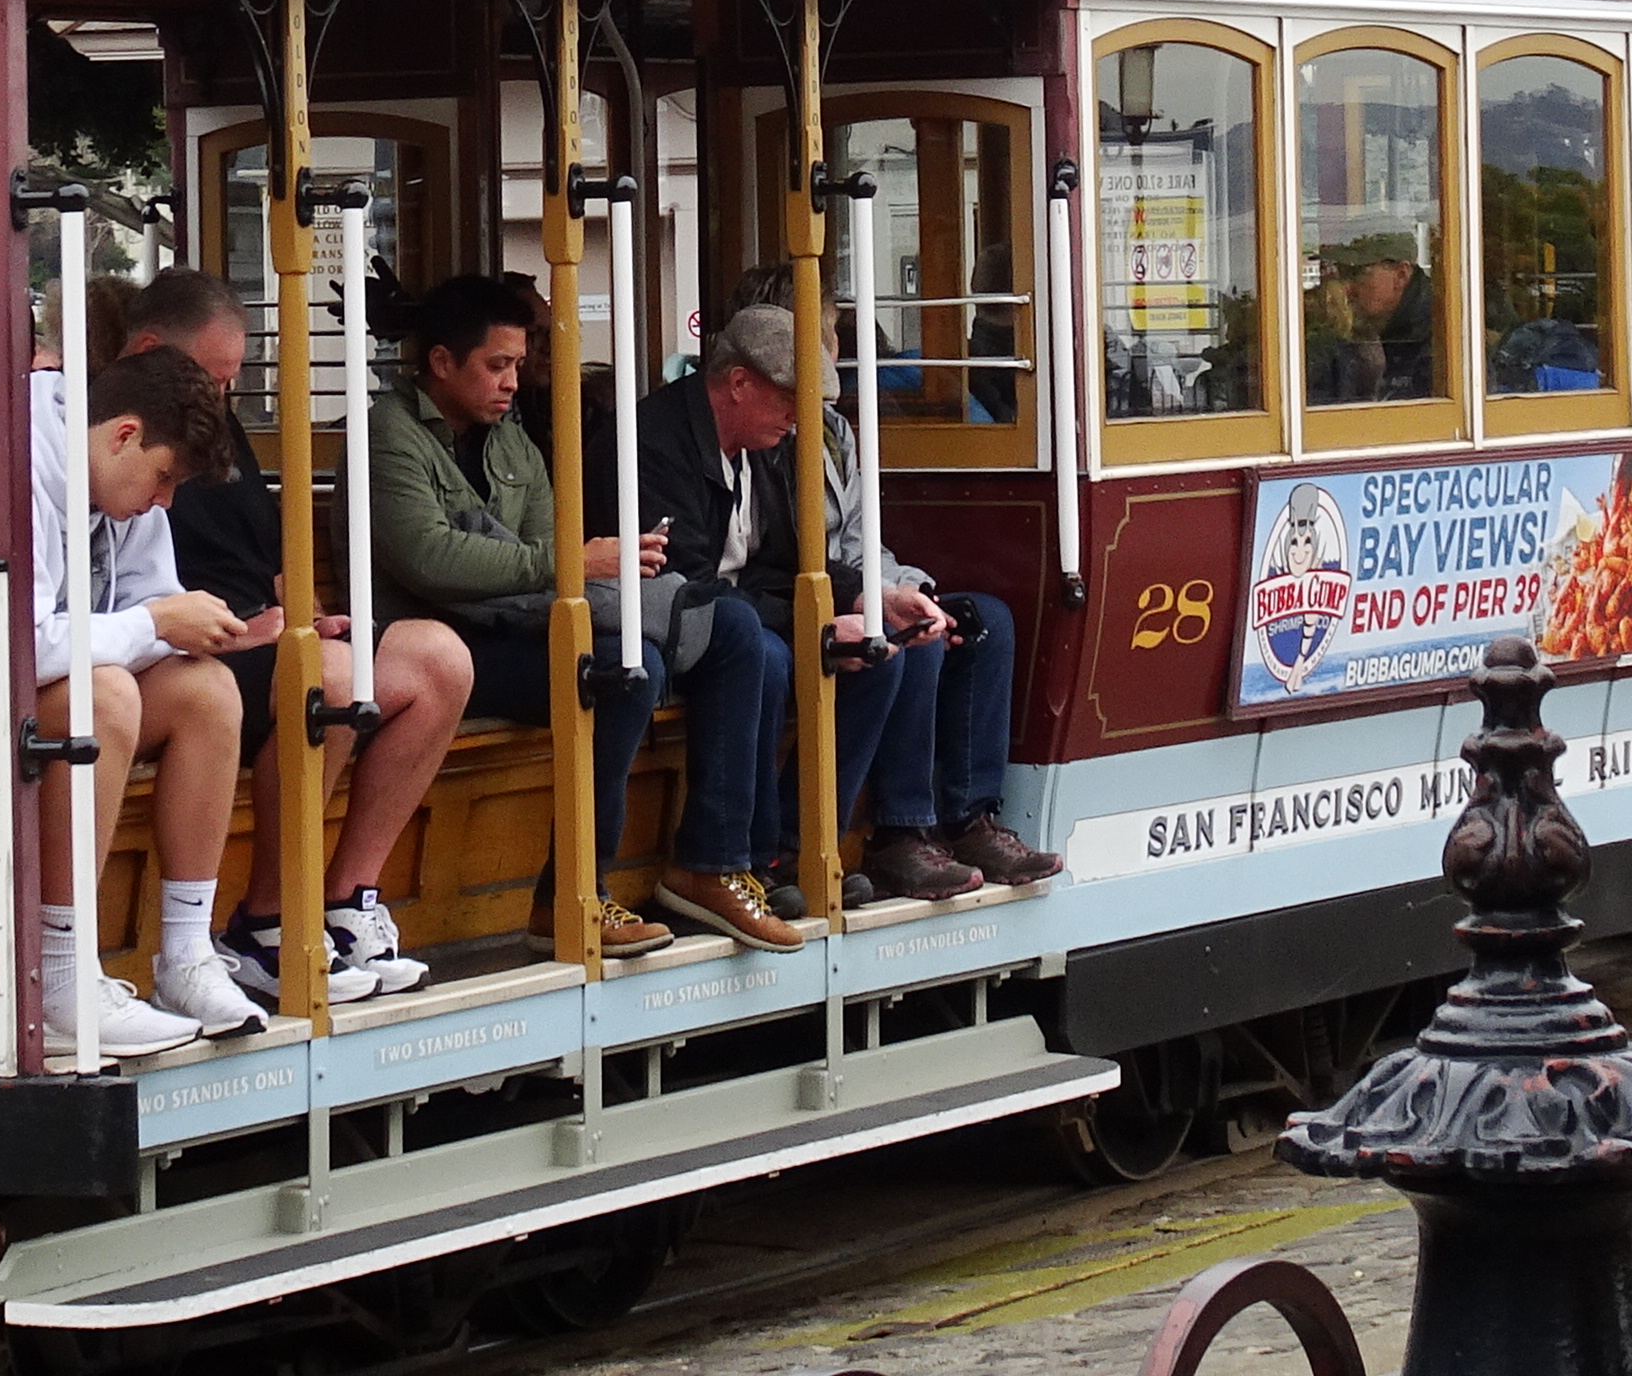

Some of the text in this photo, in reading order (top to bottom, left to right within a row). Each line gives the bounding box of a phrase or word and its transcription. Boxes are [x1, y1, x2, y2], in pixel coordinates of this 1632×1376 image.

[1362, 461, 1552, 519] SPECTACULAR
[1356, 509, 1548, 582] BAY VIEWS!
[1130, 579, 1214, 650] 28
[1257, 574, 1347, 622] BUBBA GUMP
[1350, 573, 1541, 636] END OF PIER 39
[1345, 645, 1485, 688] BUBBAGUMP.COM
[1146, 810, 1216, 859] SAN
[1228, 777, 1404, 846] FRANCISCO
[877, 924, 1000, 961] TWO STANDEES ONLY
[643, 969, 780, 1011] TWO STANDEES ONLY
[380, 1019, 529, 1065] TWO STANDEES ONLY
[139, 1066, 295, 1115] WO STANDEES ONLY
